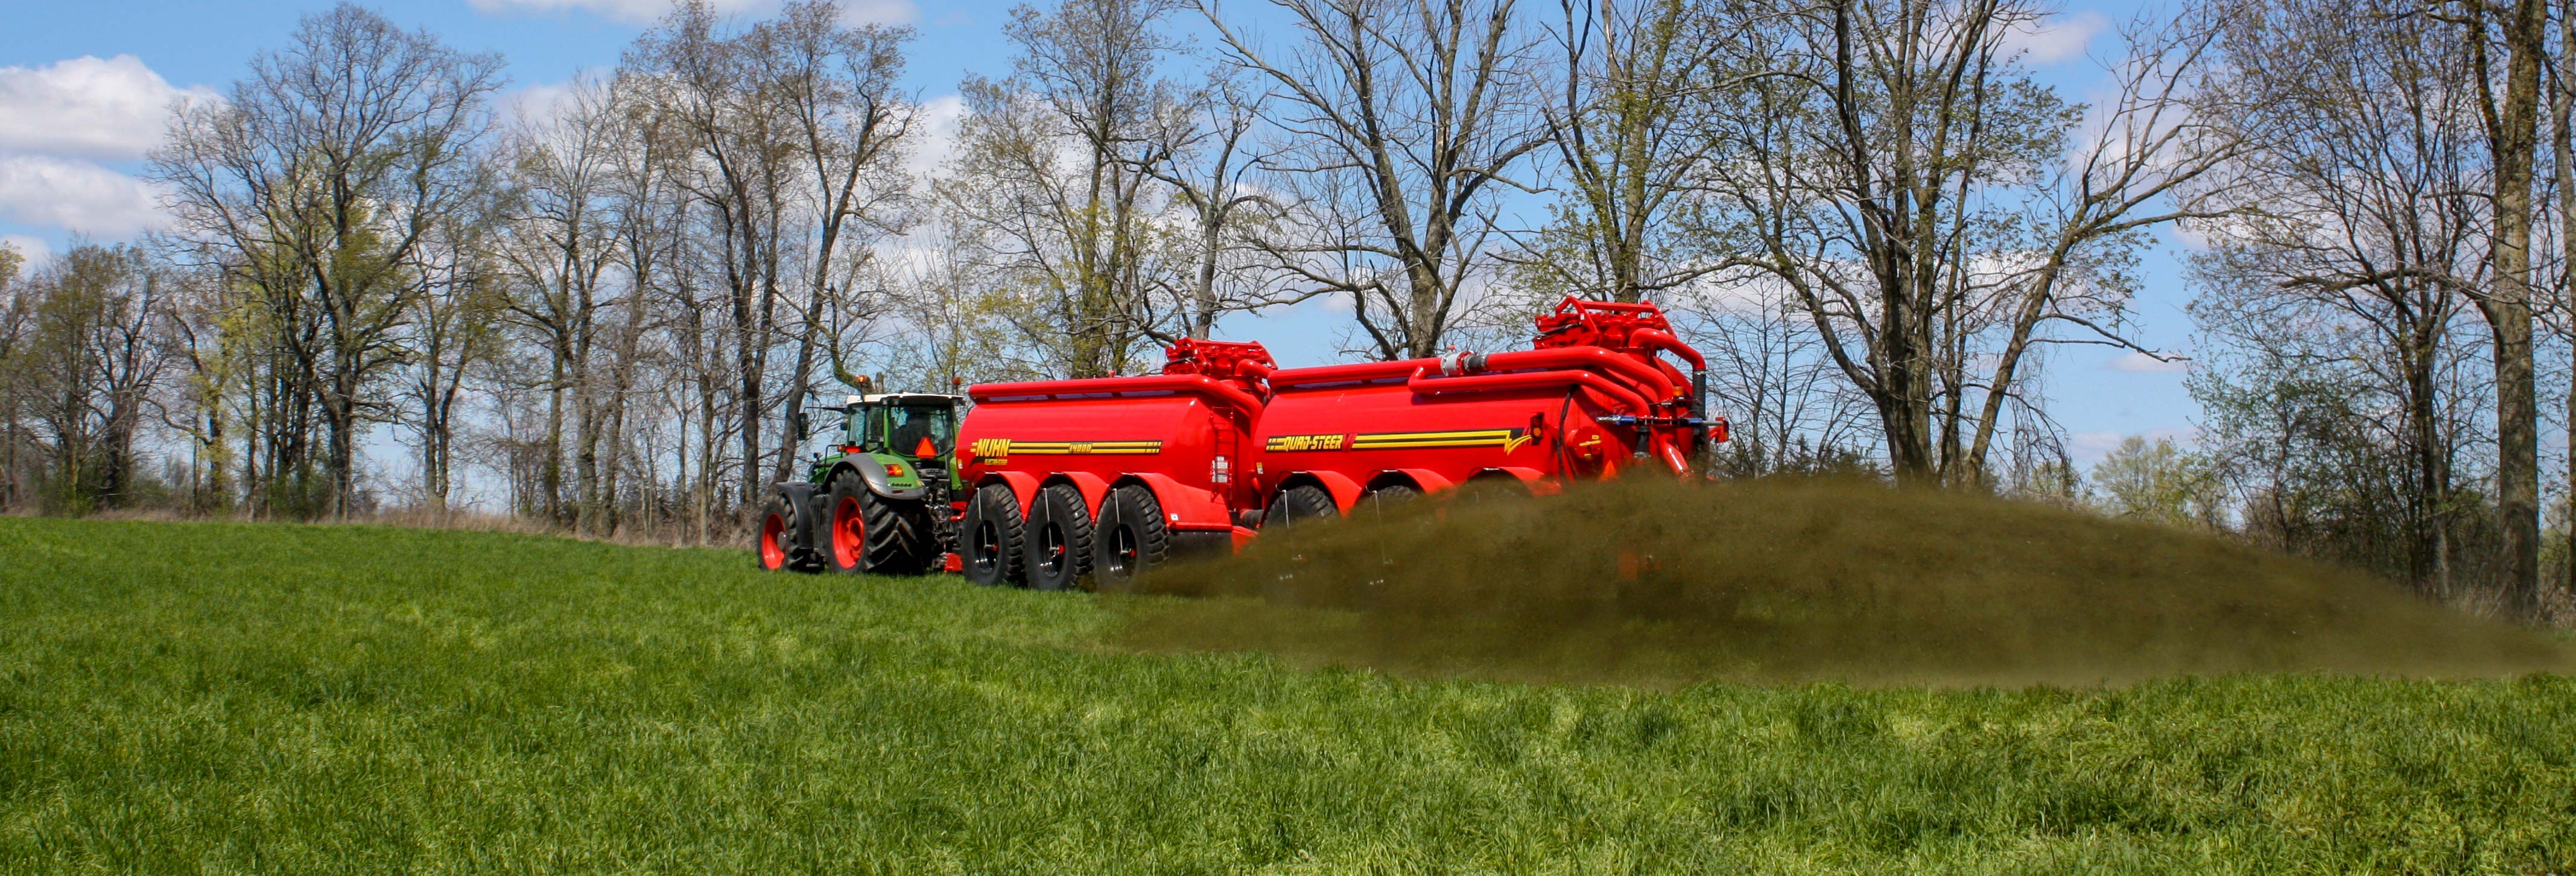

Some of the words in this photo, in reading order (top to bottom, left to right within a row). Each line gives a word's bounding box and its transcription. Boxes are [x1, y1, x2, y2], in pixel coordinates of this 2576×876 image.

[976, 439, 1010, 457] NUHN
[1070, 443, 1091, 452] 14000
[1284, 435, 1344, 451] QUAD-STEER
